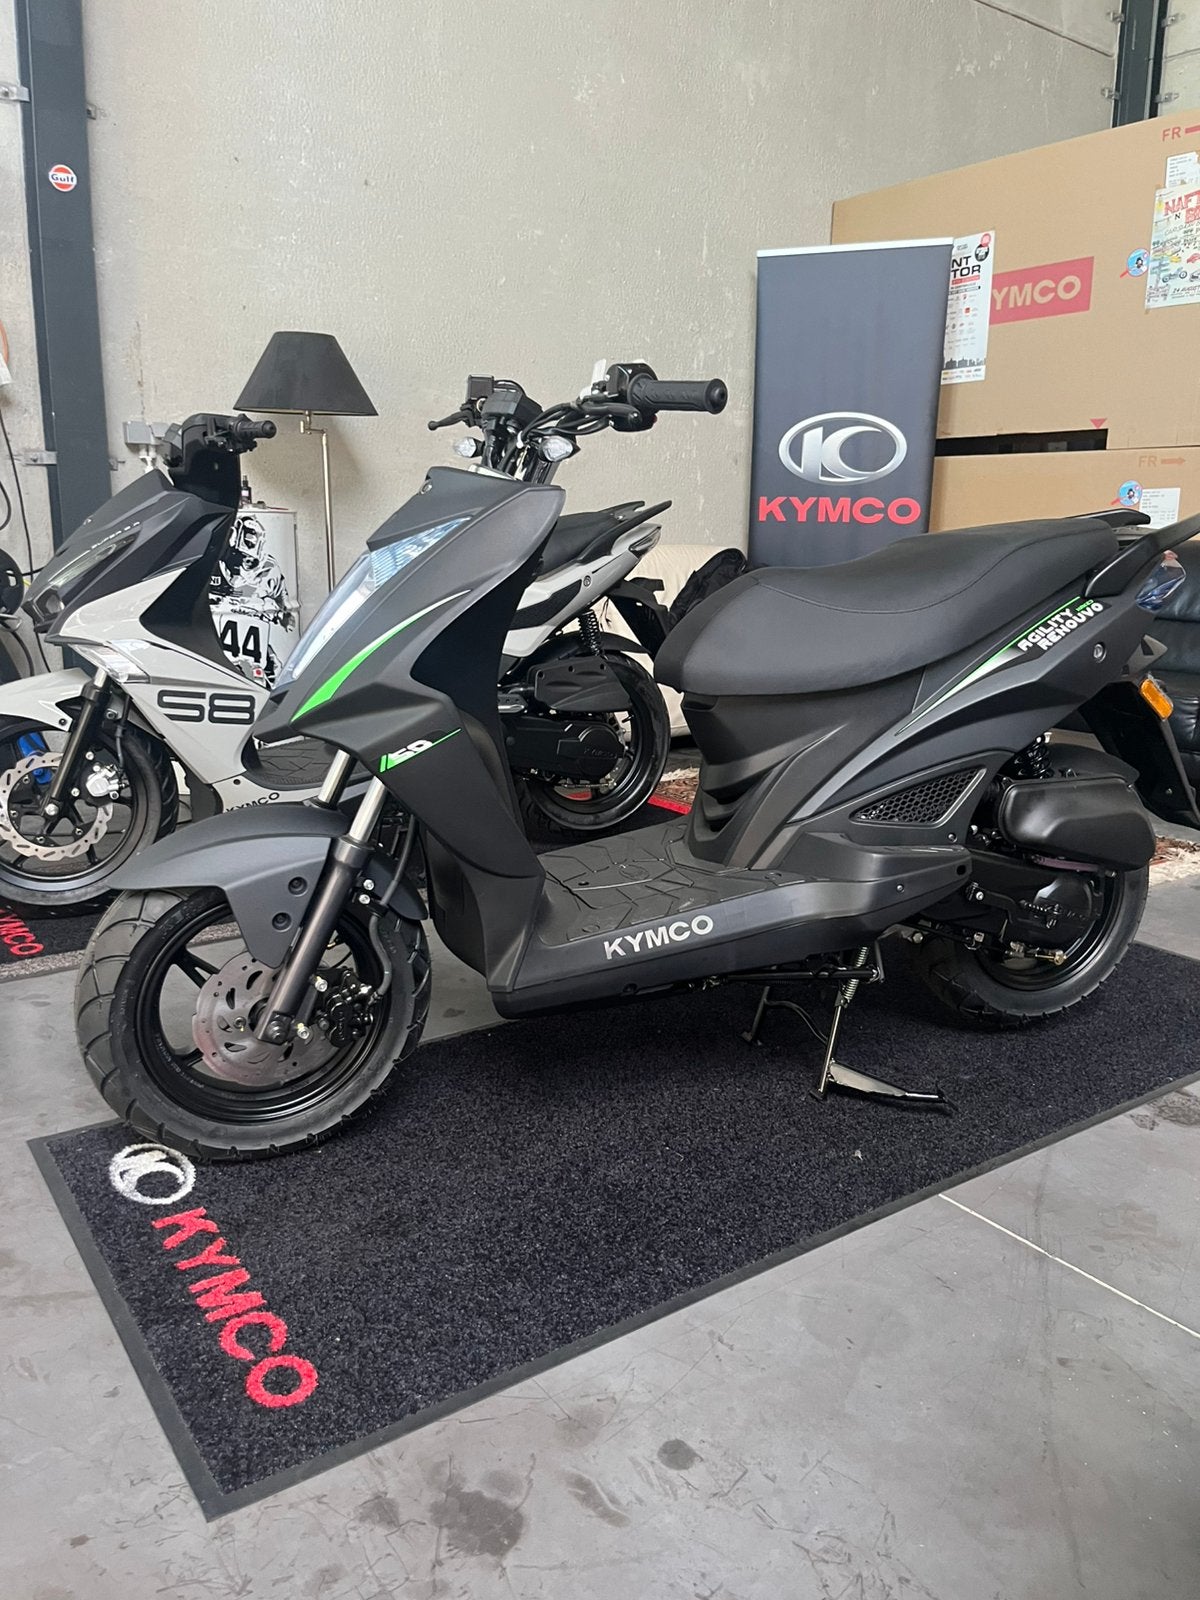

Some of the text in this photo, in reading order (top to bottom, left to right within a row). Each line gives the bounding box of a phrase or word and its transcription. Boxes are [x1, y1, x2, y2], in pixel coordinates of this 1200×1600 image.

[1161, 126, 1182, 141] FR
[51, 173, 74, 183] Gulf
[951, 255, 971, 269] NT
[951, 264, 981, 279] TOR
[1137, 455, 1159, 468] FR
[758, 495, 922, 525] KYMCO
[220, 619, 262, 664] 44
[1017, 608, 1073, 652] AGILITY
[1036, 602, 1104, 651] RENOUVO
[0, 909, 44, 955] YMCO
[603, 915, 714, 960] KYMCO
[152, 1206, 318, 1408] KYMCO
